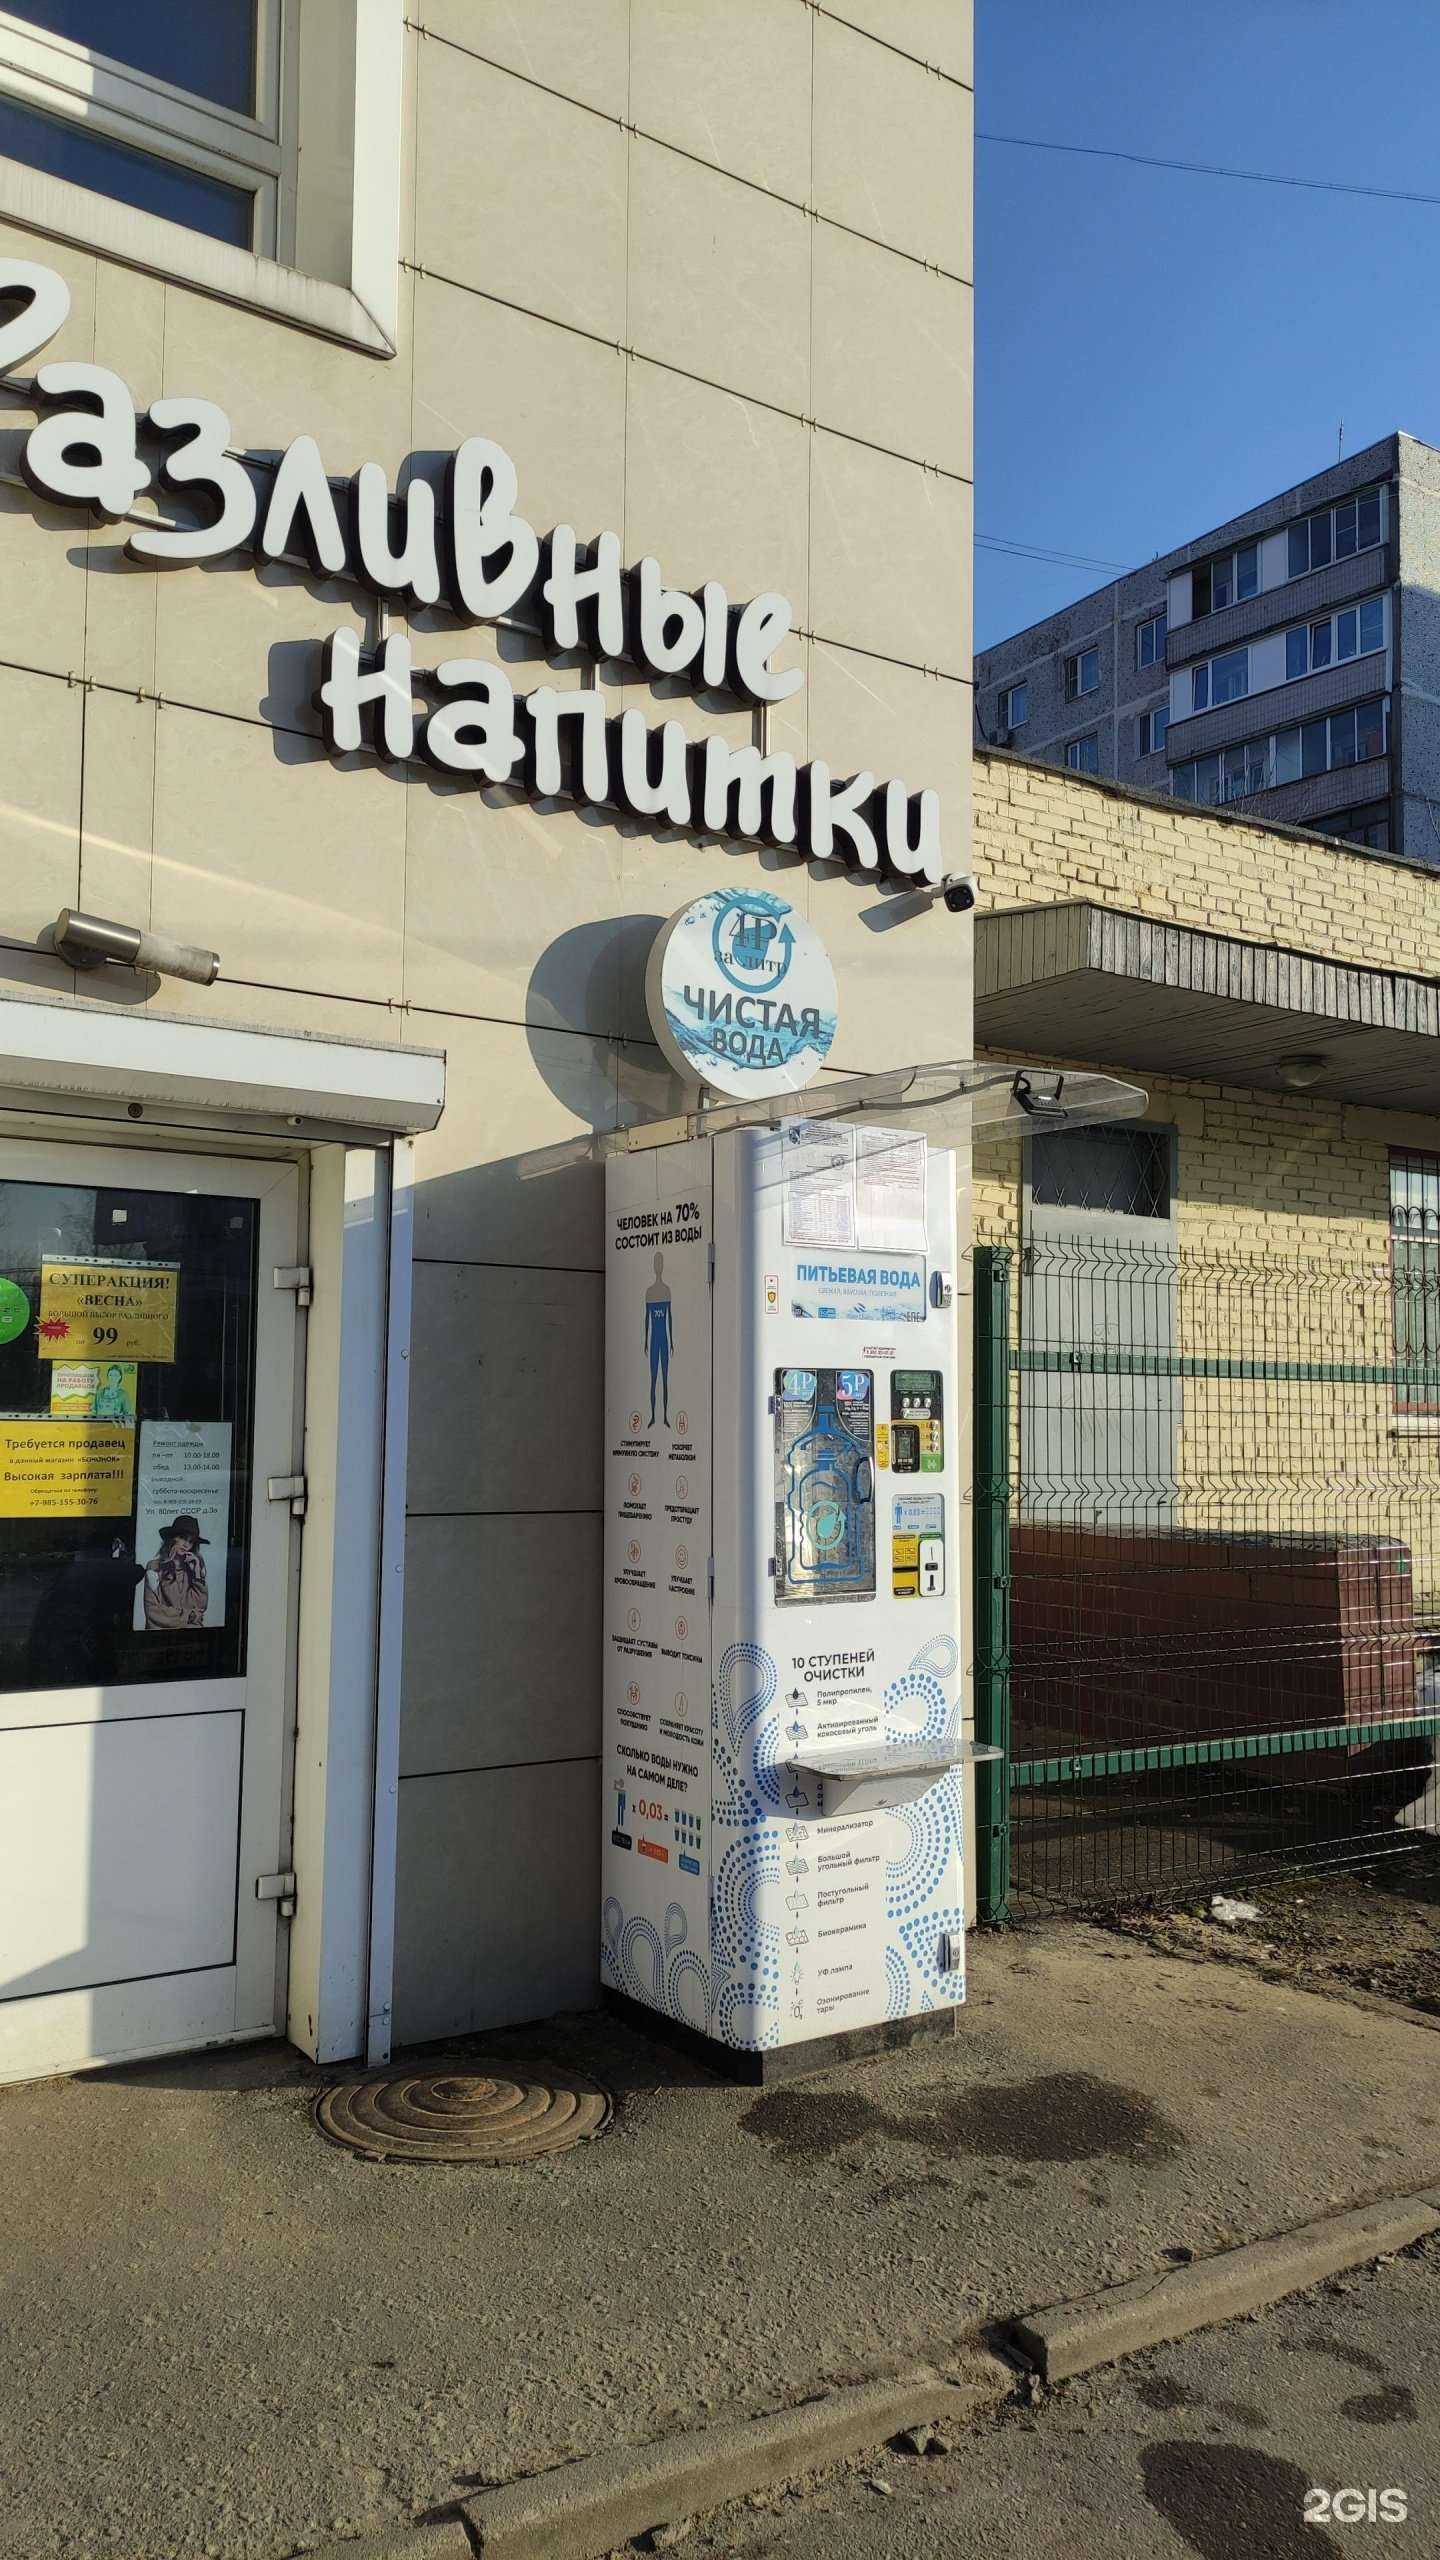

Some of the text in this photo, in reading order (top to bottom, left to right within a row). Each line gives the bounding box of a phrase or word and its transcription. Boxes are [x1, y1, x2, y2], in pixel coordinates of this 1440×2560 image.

[322, 625, 942, 885] напитки
[683, 984, 821, 1040] ЧИСТАЯ
[711, 1027, 784, 1065] ВОДА
[617, 1202, 700, 1231] ЧЕЛОВЕК НА 70%
[615, 1226, 702, 1250] СОСТОИТ ИЗ ВОДЫ
[49, 1272, 170, 1289] СУПЕРАКЦИЯ!
[796, 1264, 921, 1290] ПИТЬЕВАЯ ВОДА
[77, 1294, 143, 1307] «ВЕСНА»
[92, 1327, 118, 1345] 99
[6, 1439, 126, 1450] Требуется продавец
[4, 1469, 124, 1482] Высокая зарплата!!!
[791, 1648, 875, 1669] 10 СТУПЕНЕЙ
[804, 1666, 865, 1682] ОЧИСТКИ
[817, 1686, 873, 1699] Полипропилен,
[817, 1716, 879, 1730] Активированный
[817, 1725, 877, 1738] кокосовый уголь
[616, 1744, 699, 1777] СКОЛЬКО ВОДЫ НУЖНО
[626, 1765, 688, 1792] НА САМОМ ДЕЛЕ?
[639, 1799, 663, 1821] 0,03
[817, 1820, 873, 1834] Минерализатор
[817, 1851, 851, 1863] Большой
[817, 1855, 880, 1872] угольный фильтр
[817, 1883, 869, 1899] Постугольный
[817, 1897, 845, 1908] фильтр
[817, 1923, 867, 1938] Биокерамика
[817, 1964, 853, 1976] УФ лампа
[816, 1989, 870, 2005] Озонирование
[817, 2005, 835, 2014] тары
